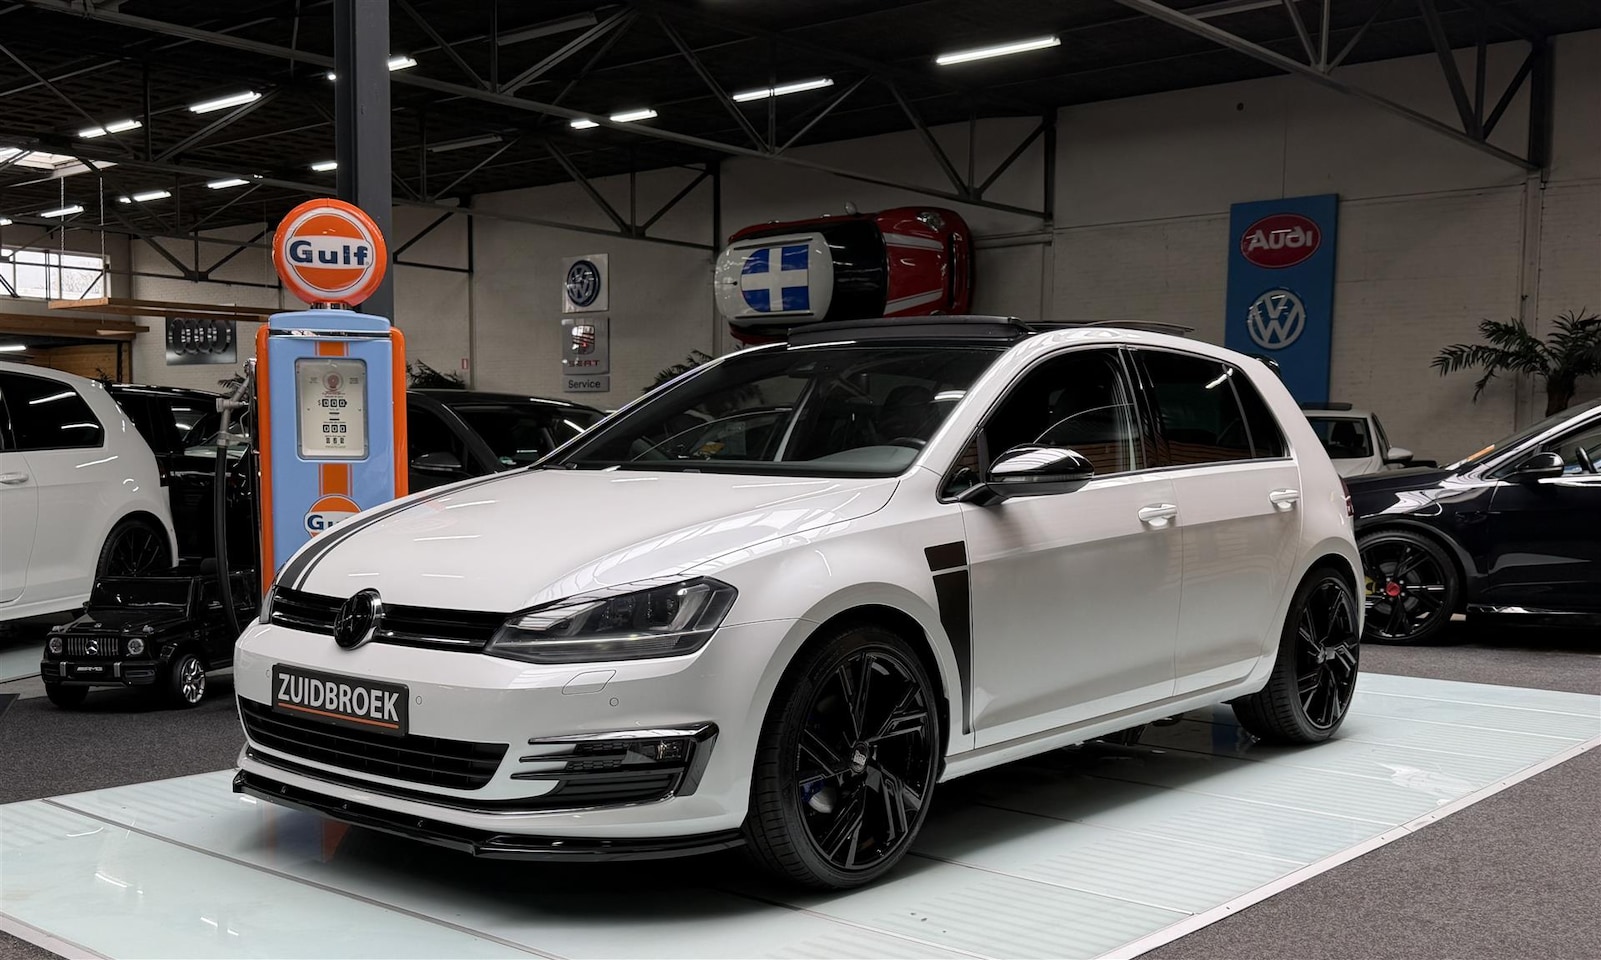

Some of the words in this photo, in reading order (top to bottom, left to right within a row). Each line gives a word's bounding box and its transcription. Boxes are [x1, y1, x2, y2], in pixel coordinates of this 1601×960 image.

[289, 239, 368, 266] Gulf
[568, 379, 601, 389] Service
[278, 673, 399, 722] ZUIDBROEK
